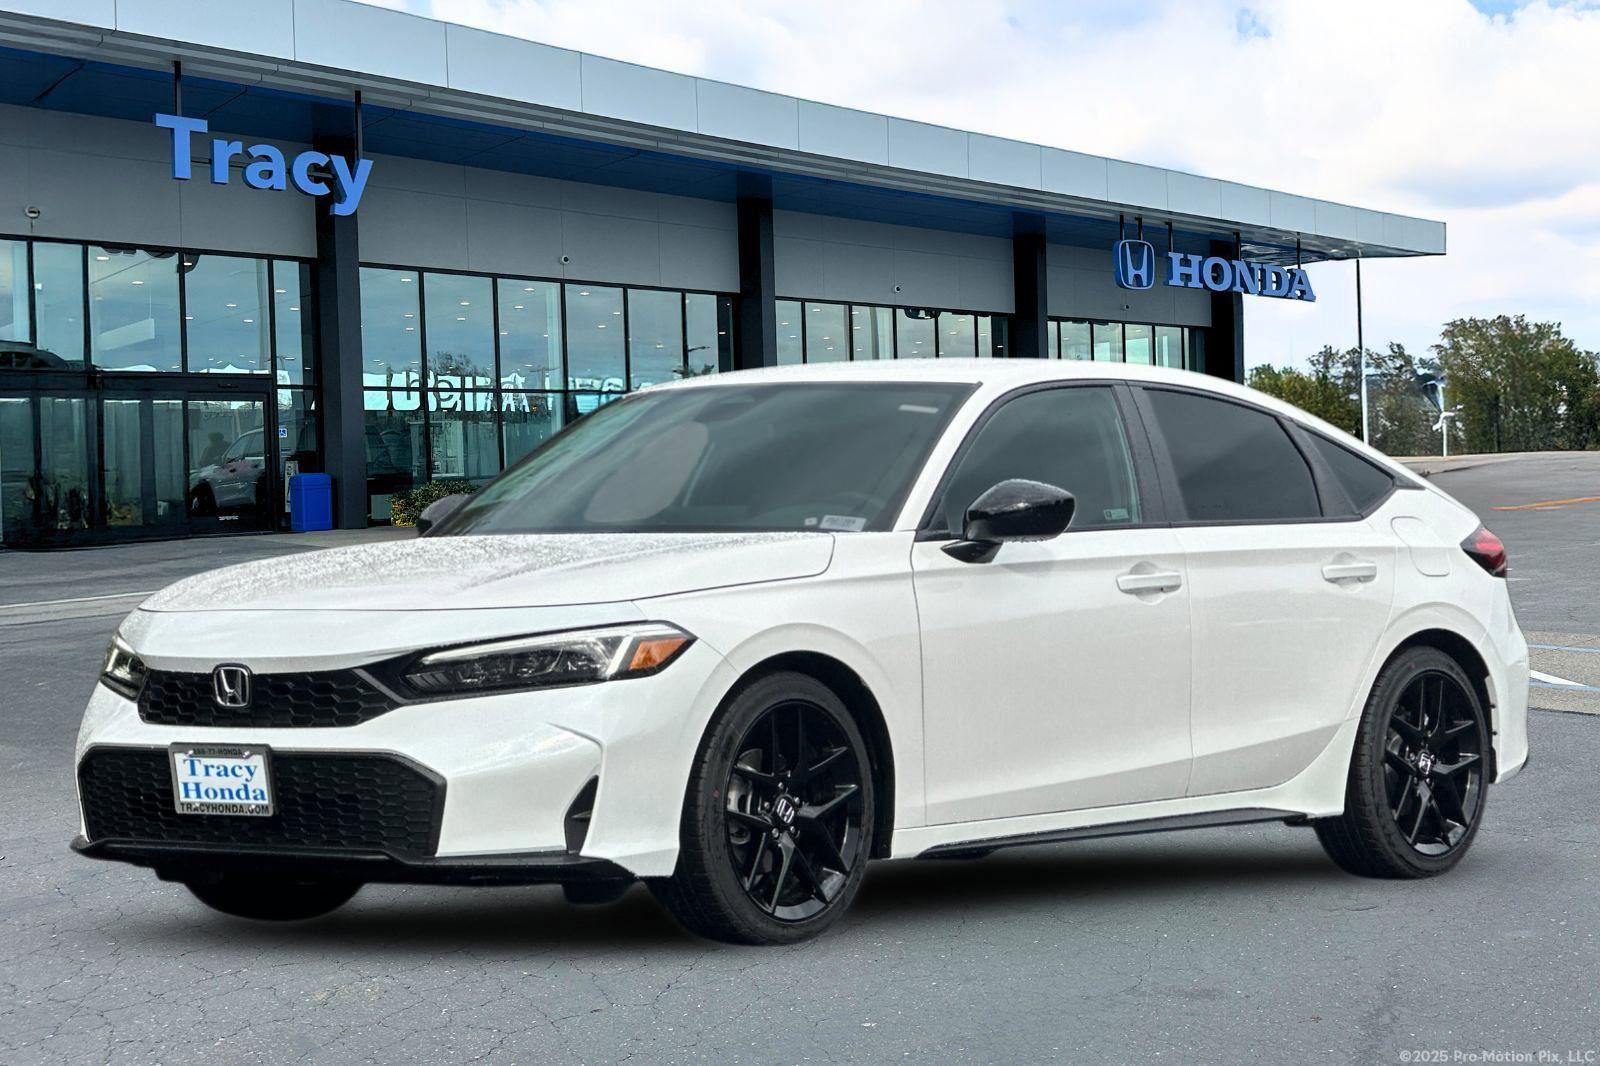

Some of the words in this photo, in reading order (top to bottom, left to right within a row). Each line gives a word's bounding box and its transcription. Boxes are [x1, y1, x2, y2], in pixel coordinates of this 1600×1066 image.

[155, 113, 374, 216] Tracy
[1167, 251, 1316, 301] HONDA
[183, 758, 257, 782] Tracy
[182, 782, 267, 801] Honda
[181, 803, 270, 814] TRACYHONDA.COM
